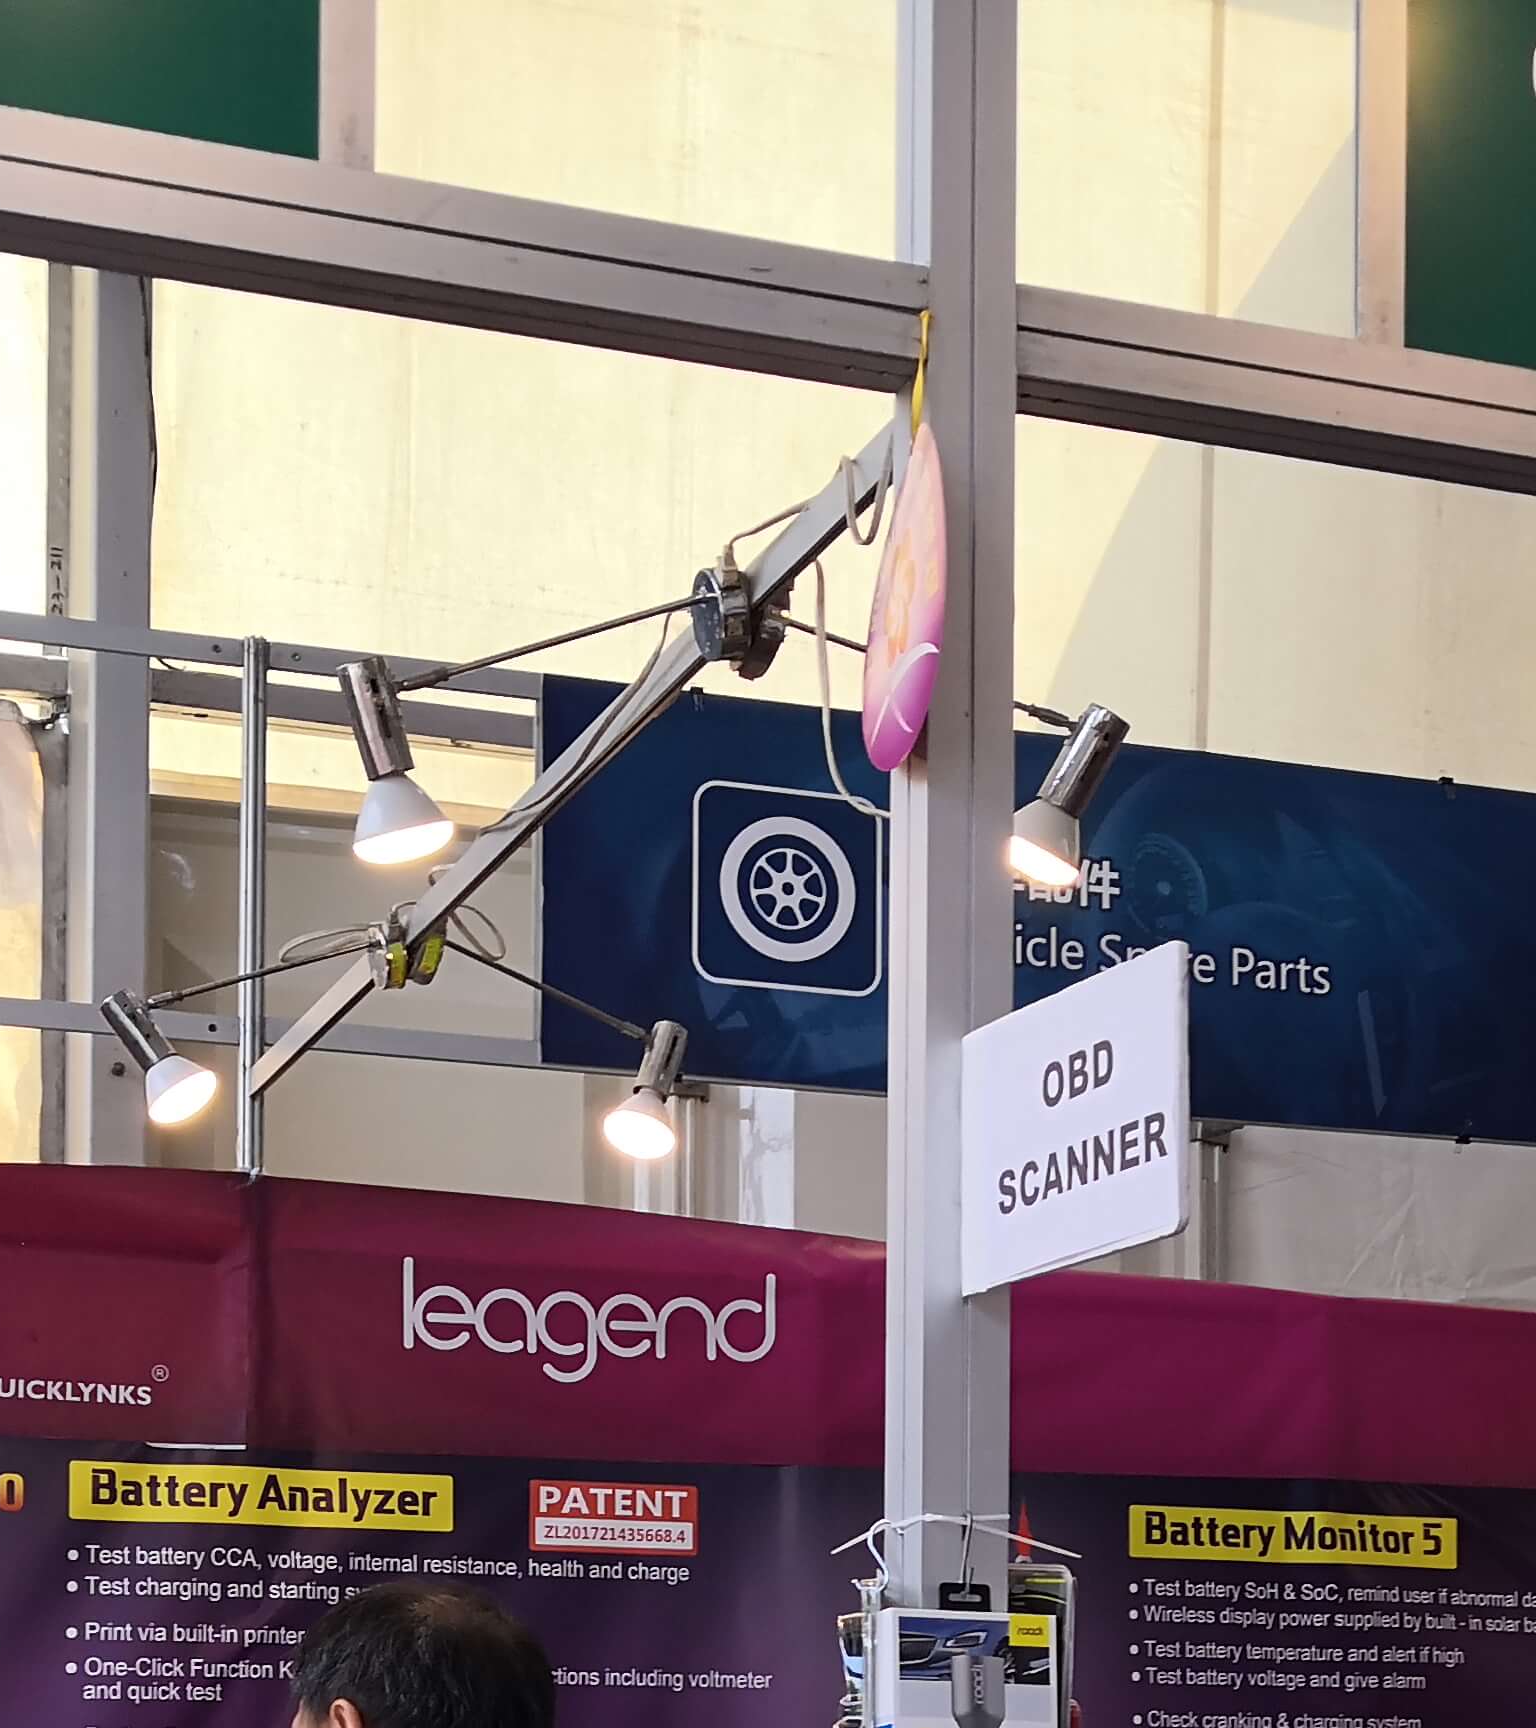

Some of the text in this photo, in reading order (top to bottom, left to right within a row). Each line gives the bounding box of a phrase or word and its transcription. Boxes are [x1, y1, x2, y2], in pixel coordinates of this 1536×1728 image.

[1014, 922, 1085, 970] icle
[1231, 947, 1332, 995] Parts
[1041, 1038, 1113, 1110] OBD
[996, 1110, 1168, 1216] SCANNER
[402, 1256, 777, 1384] leagend
[92, 1469, 437, 1522] Battery Analyzer
[536, 1486, 688, 1522] PATENT
[1145, 1511, 1442, 1557] Battery Monitor 5
[85, 1545, 689, 1585] Test battery CCA, voltage, internal resistance, health and charge
[86, 1622, 305, 1647] Print via built-in printer
[83, 1681, 222, 1704] and quick test
[1145, 1667, 1425, 1692] Test battery voltage and give alarm
[1148, 1710, 1198, 1728] Check
